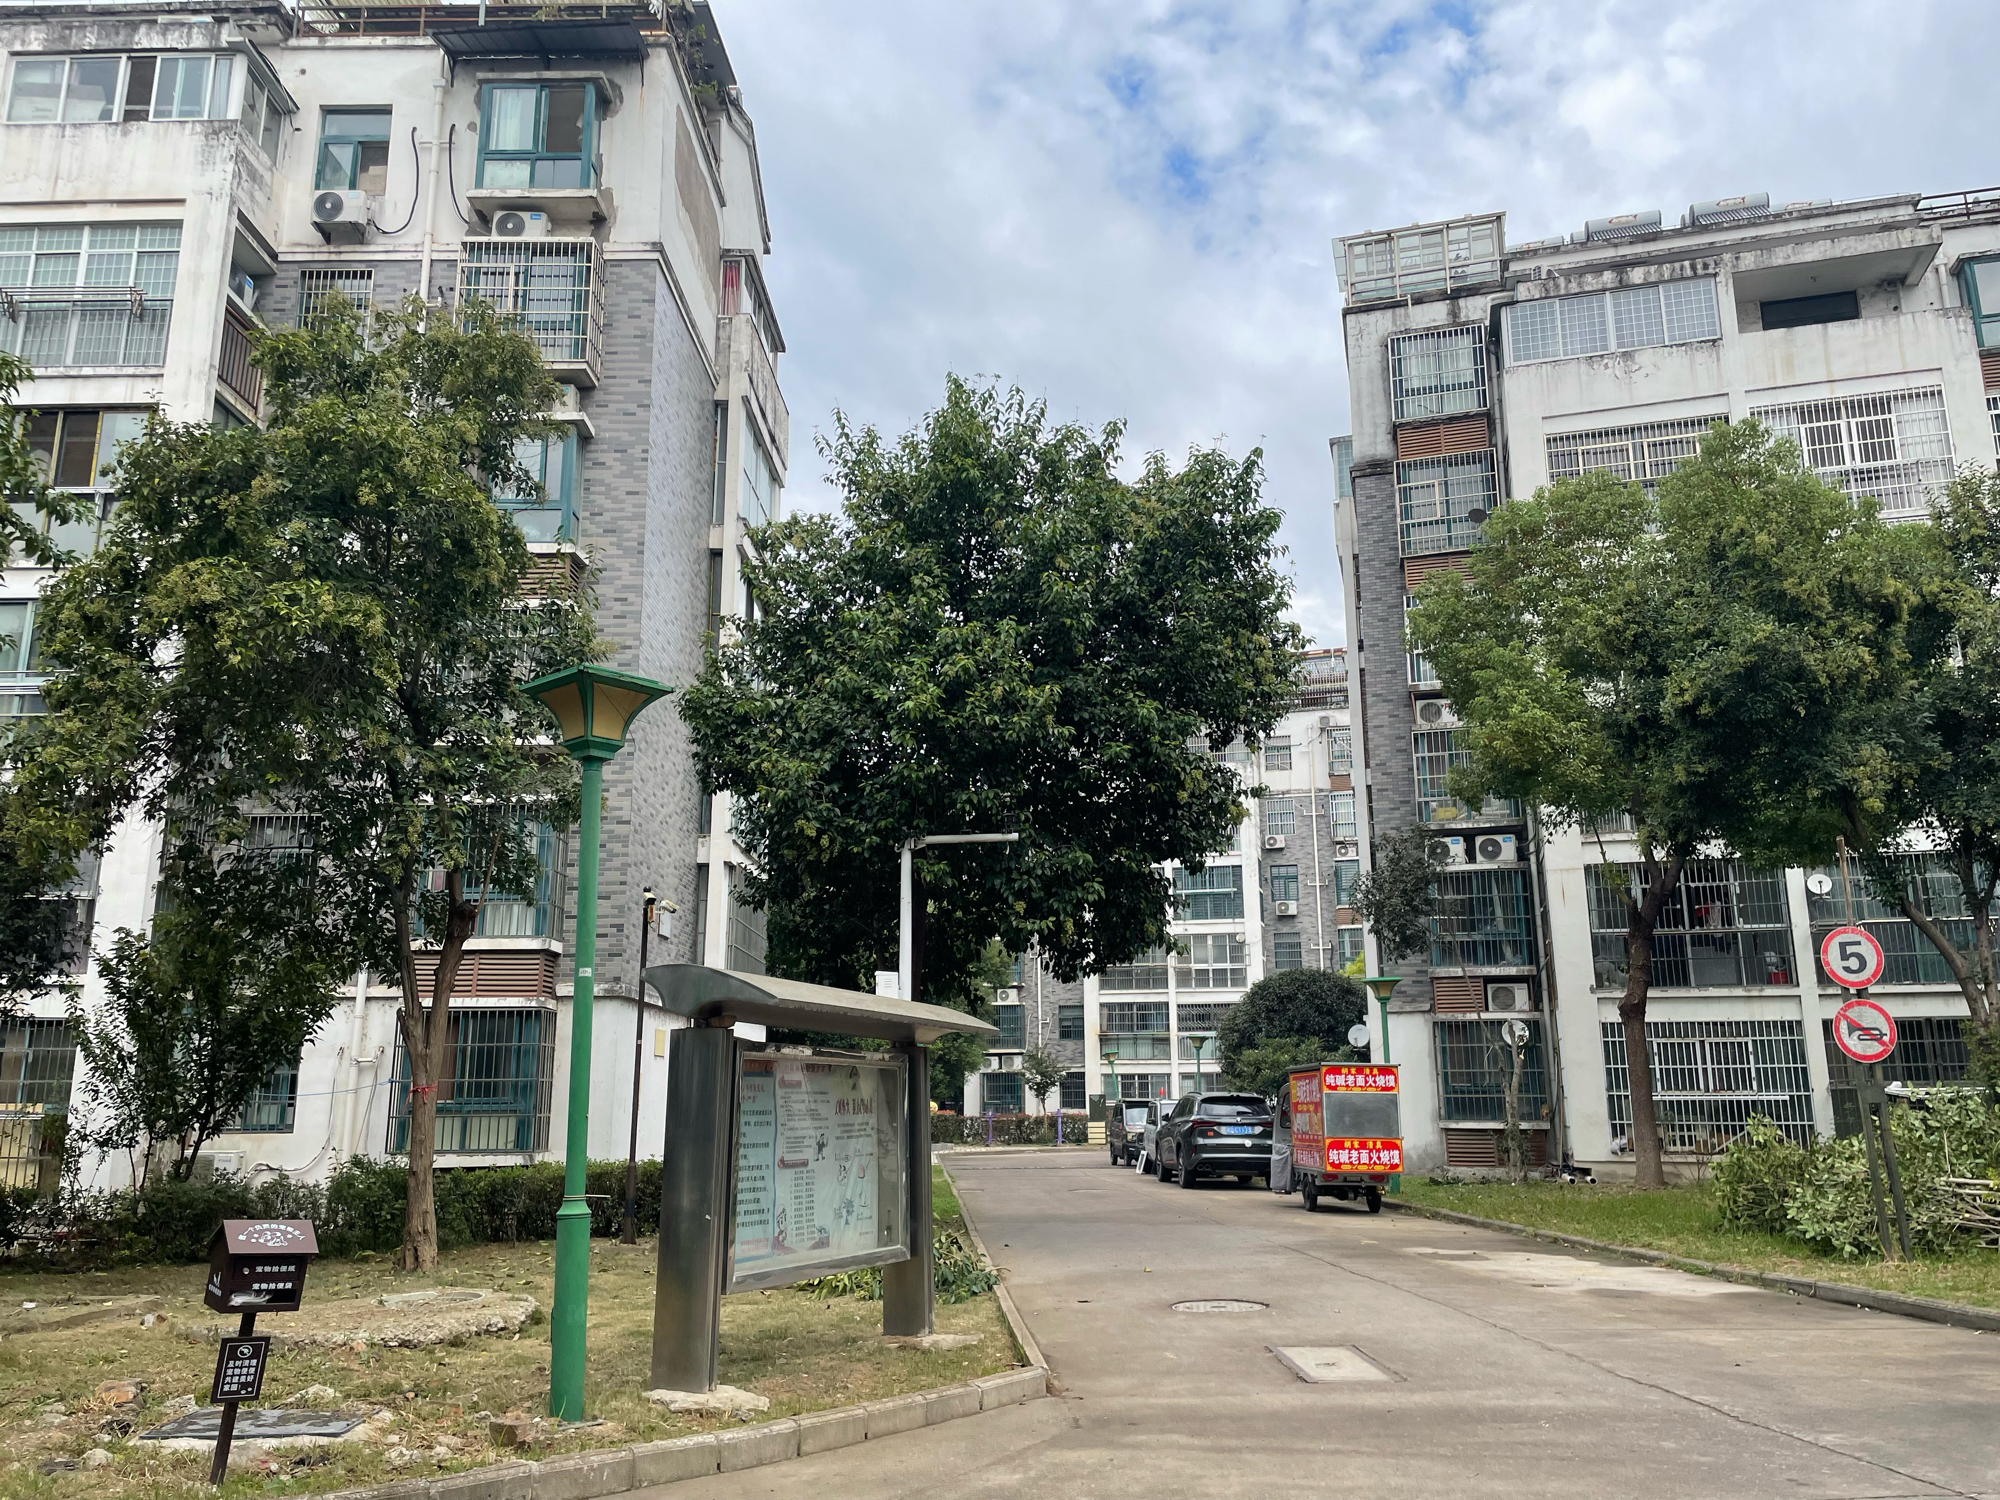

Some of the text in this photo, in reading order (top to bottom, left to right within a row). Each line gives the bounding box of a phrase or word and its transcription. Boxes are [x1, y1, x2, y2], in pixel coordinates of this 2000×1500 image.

[1839, 941, 1867, 974] 5
[1325, 1074, 1396, 1087] 纯碱老面火烧馍
[1328, 1149, 1400, 1164] 纯碱老面火烧馍
[227, 1359, 258, 1367] 及时清理
[224, 1375, 254, 1383] 共建美好
